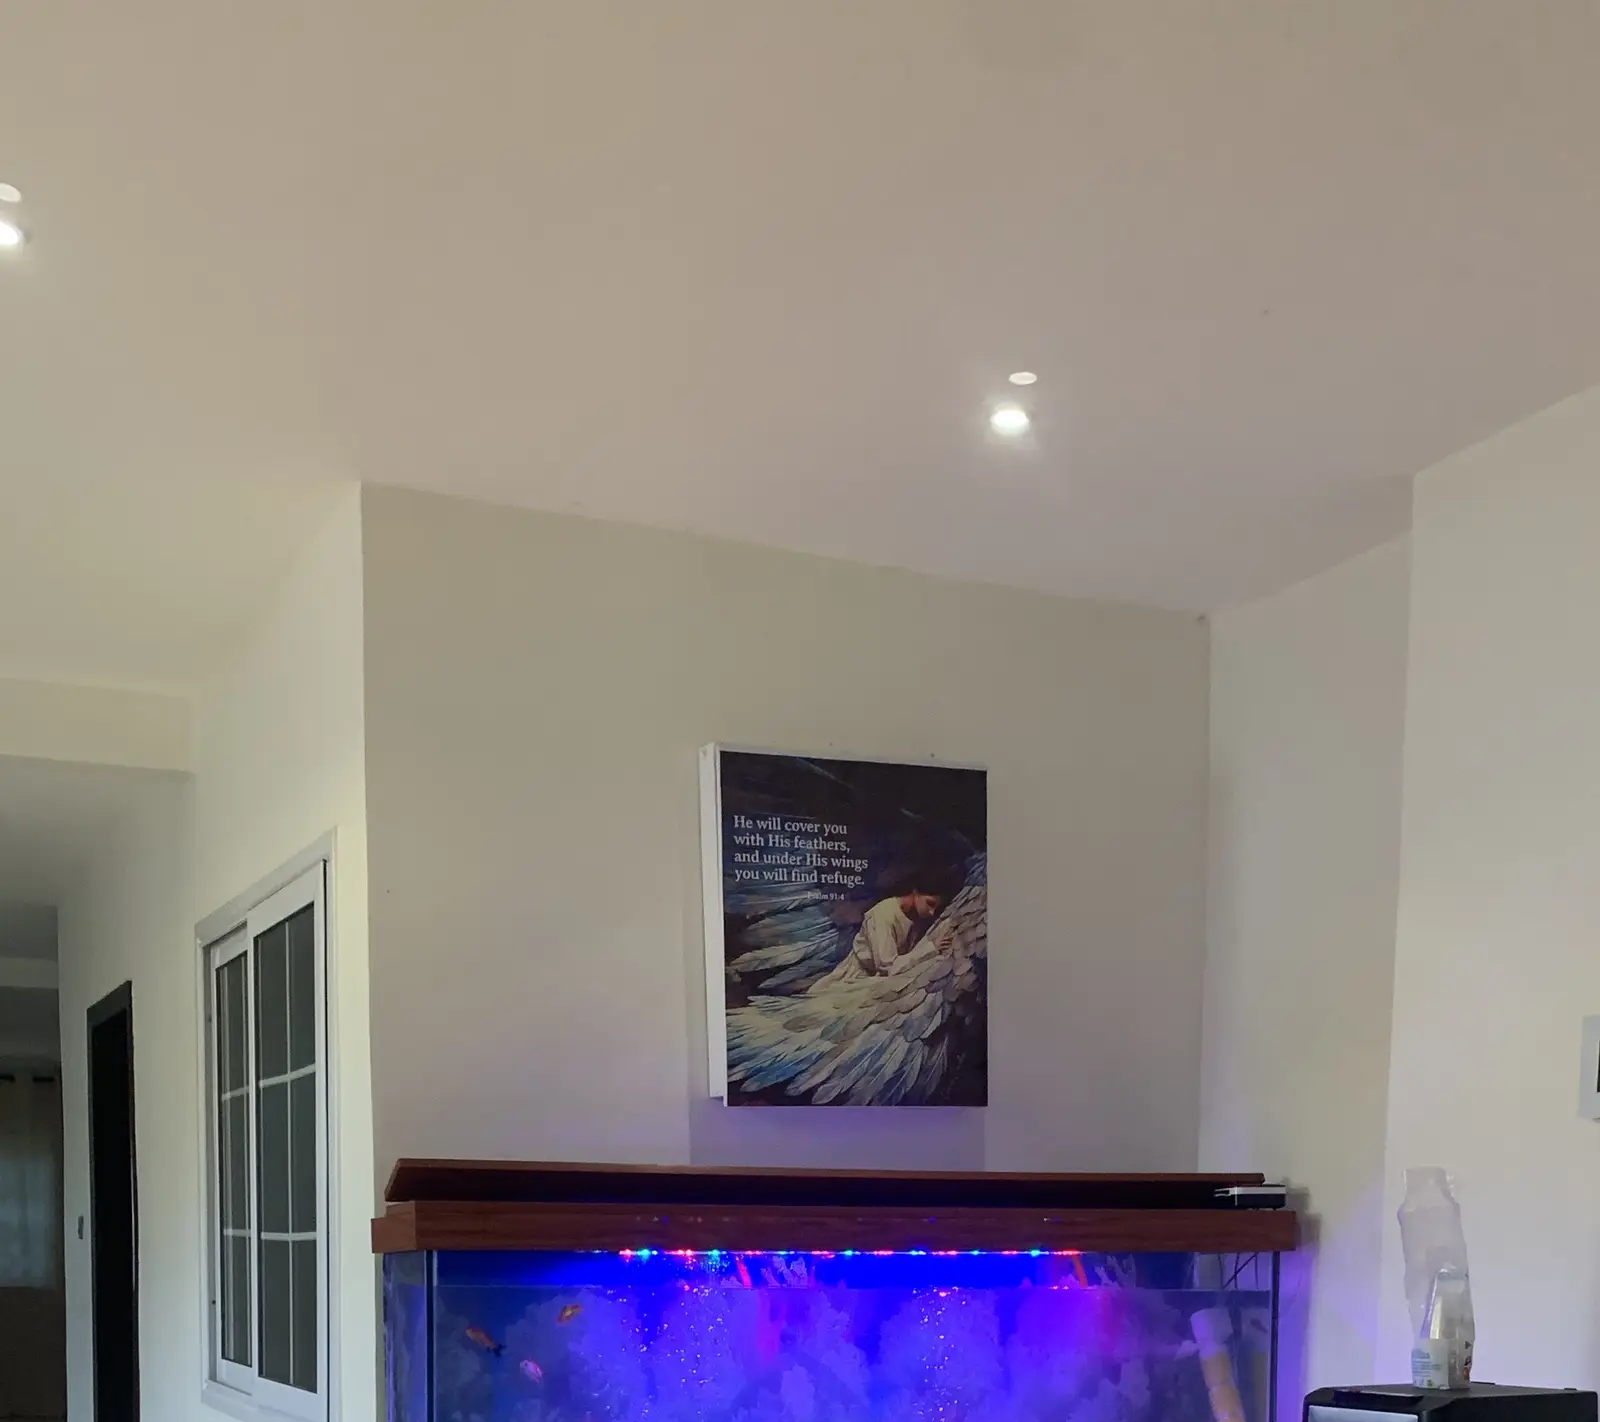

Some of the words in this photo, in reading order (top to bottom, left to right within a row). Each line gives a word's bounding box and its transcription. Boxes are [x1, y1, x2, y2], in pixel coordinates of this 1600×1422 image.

[733, 815, 753, 829] He
[756, 817, 781, 831] will
[784, 821, 820, 833] cover
[823, 823, 847, 836] you
[733, 833, 764, 847] with
[768, 834, 791, 848] His
[793, 835, 850, 853] feathers,
[734, 850, 759, 863] and
[762, 852, 802, 866] under
[805, 853, 828, 867] His
[830, 855, 868, 872] wings
[735, 868, 760, 882] you
[762, 868, 788, 881] will
[791, 868, 818, 883] find
[821, 871, 865, 888] refuge.
